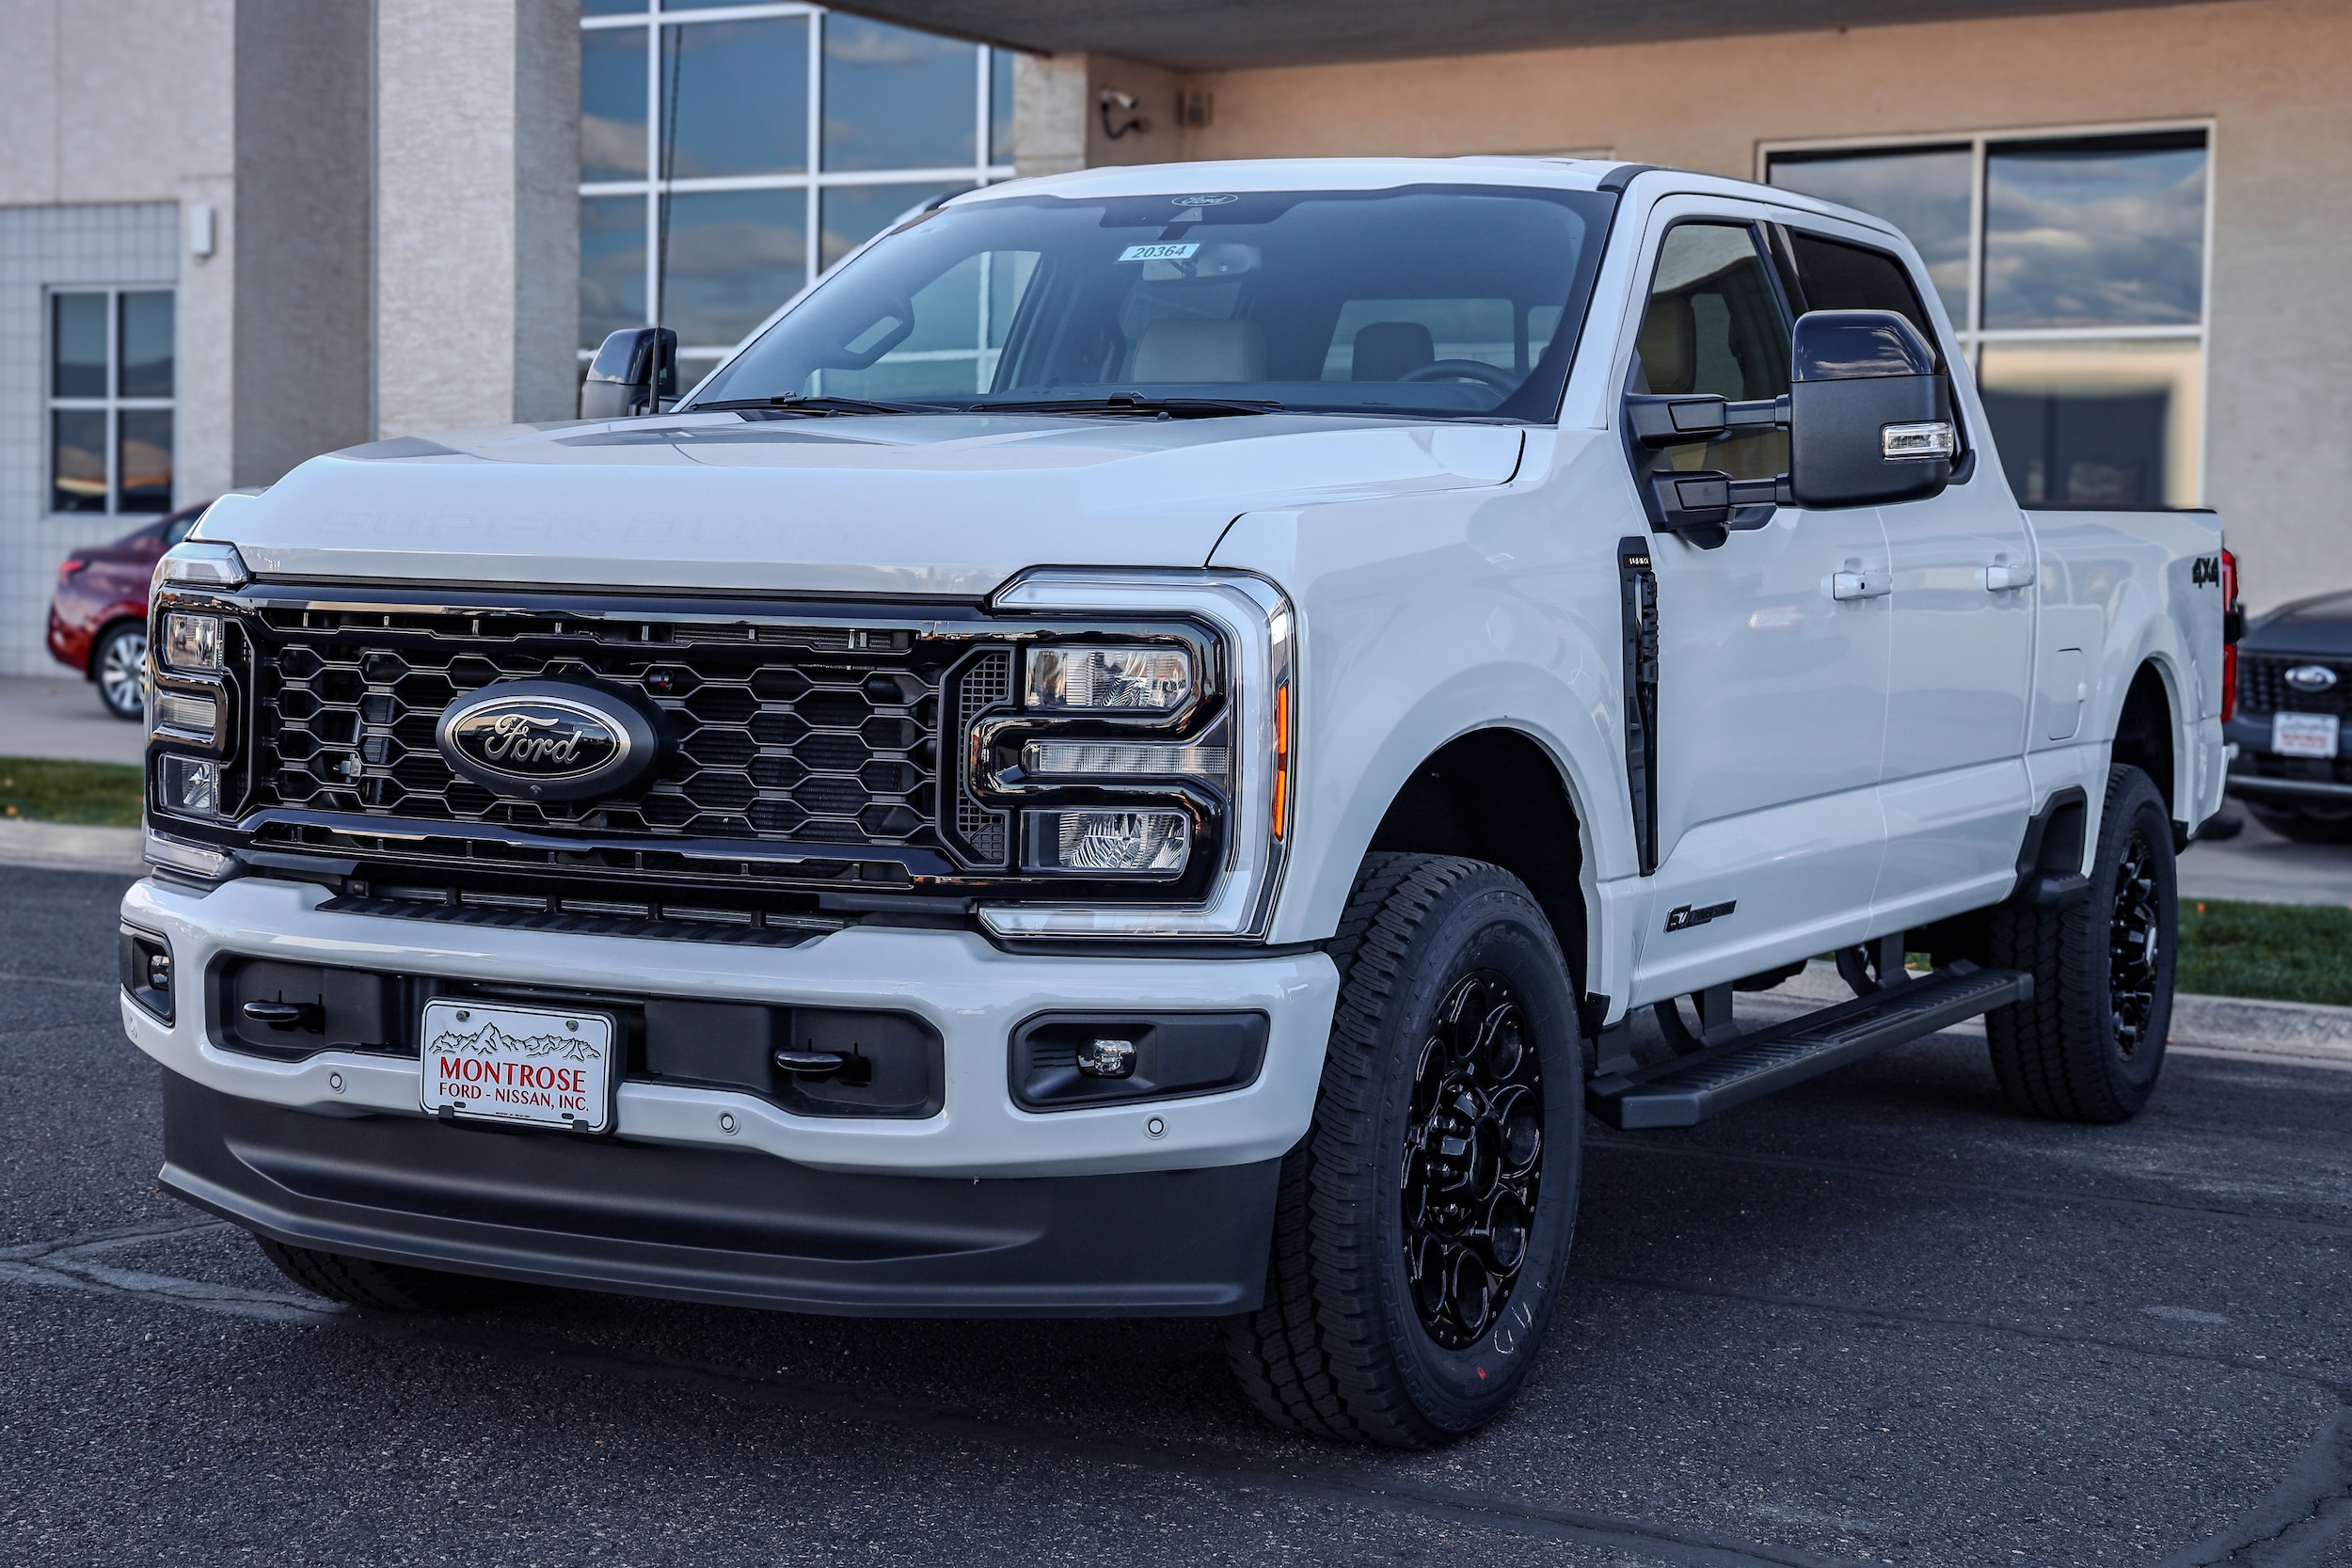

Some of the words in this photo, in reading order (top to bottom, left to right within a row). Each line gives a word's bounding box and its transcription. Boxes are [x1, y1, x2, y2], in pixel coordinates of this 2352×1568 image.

[1182, 195, 1226, 204] Ford
[1131, 245, 1188, 259] 20364
[484, 713, 584, 765] Ford
[440, 1056, 586, 1093] MONTROSE
[439, 1082, 482, 1099] FORD
[495, 1088, 555, 1110] NISSAN,
[559, 1095, 590, 1111] INC.
